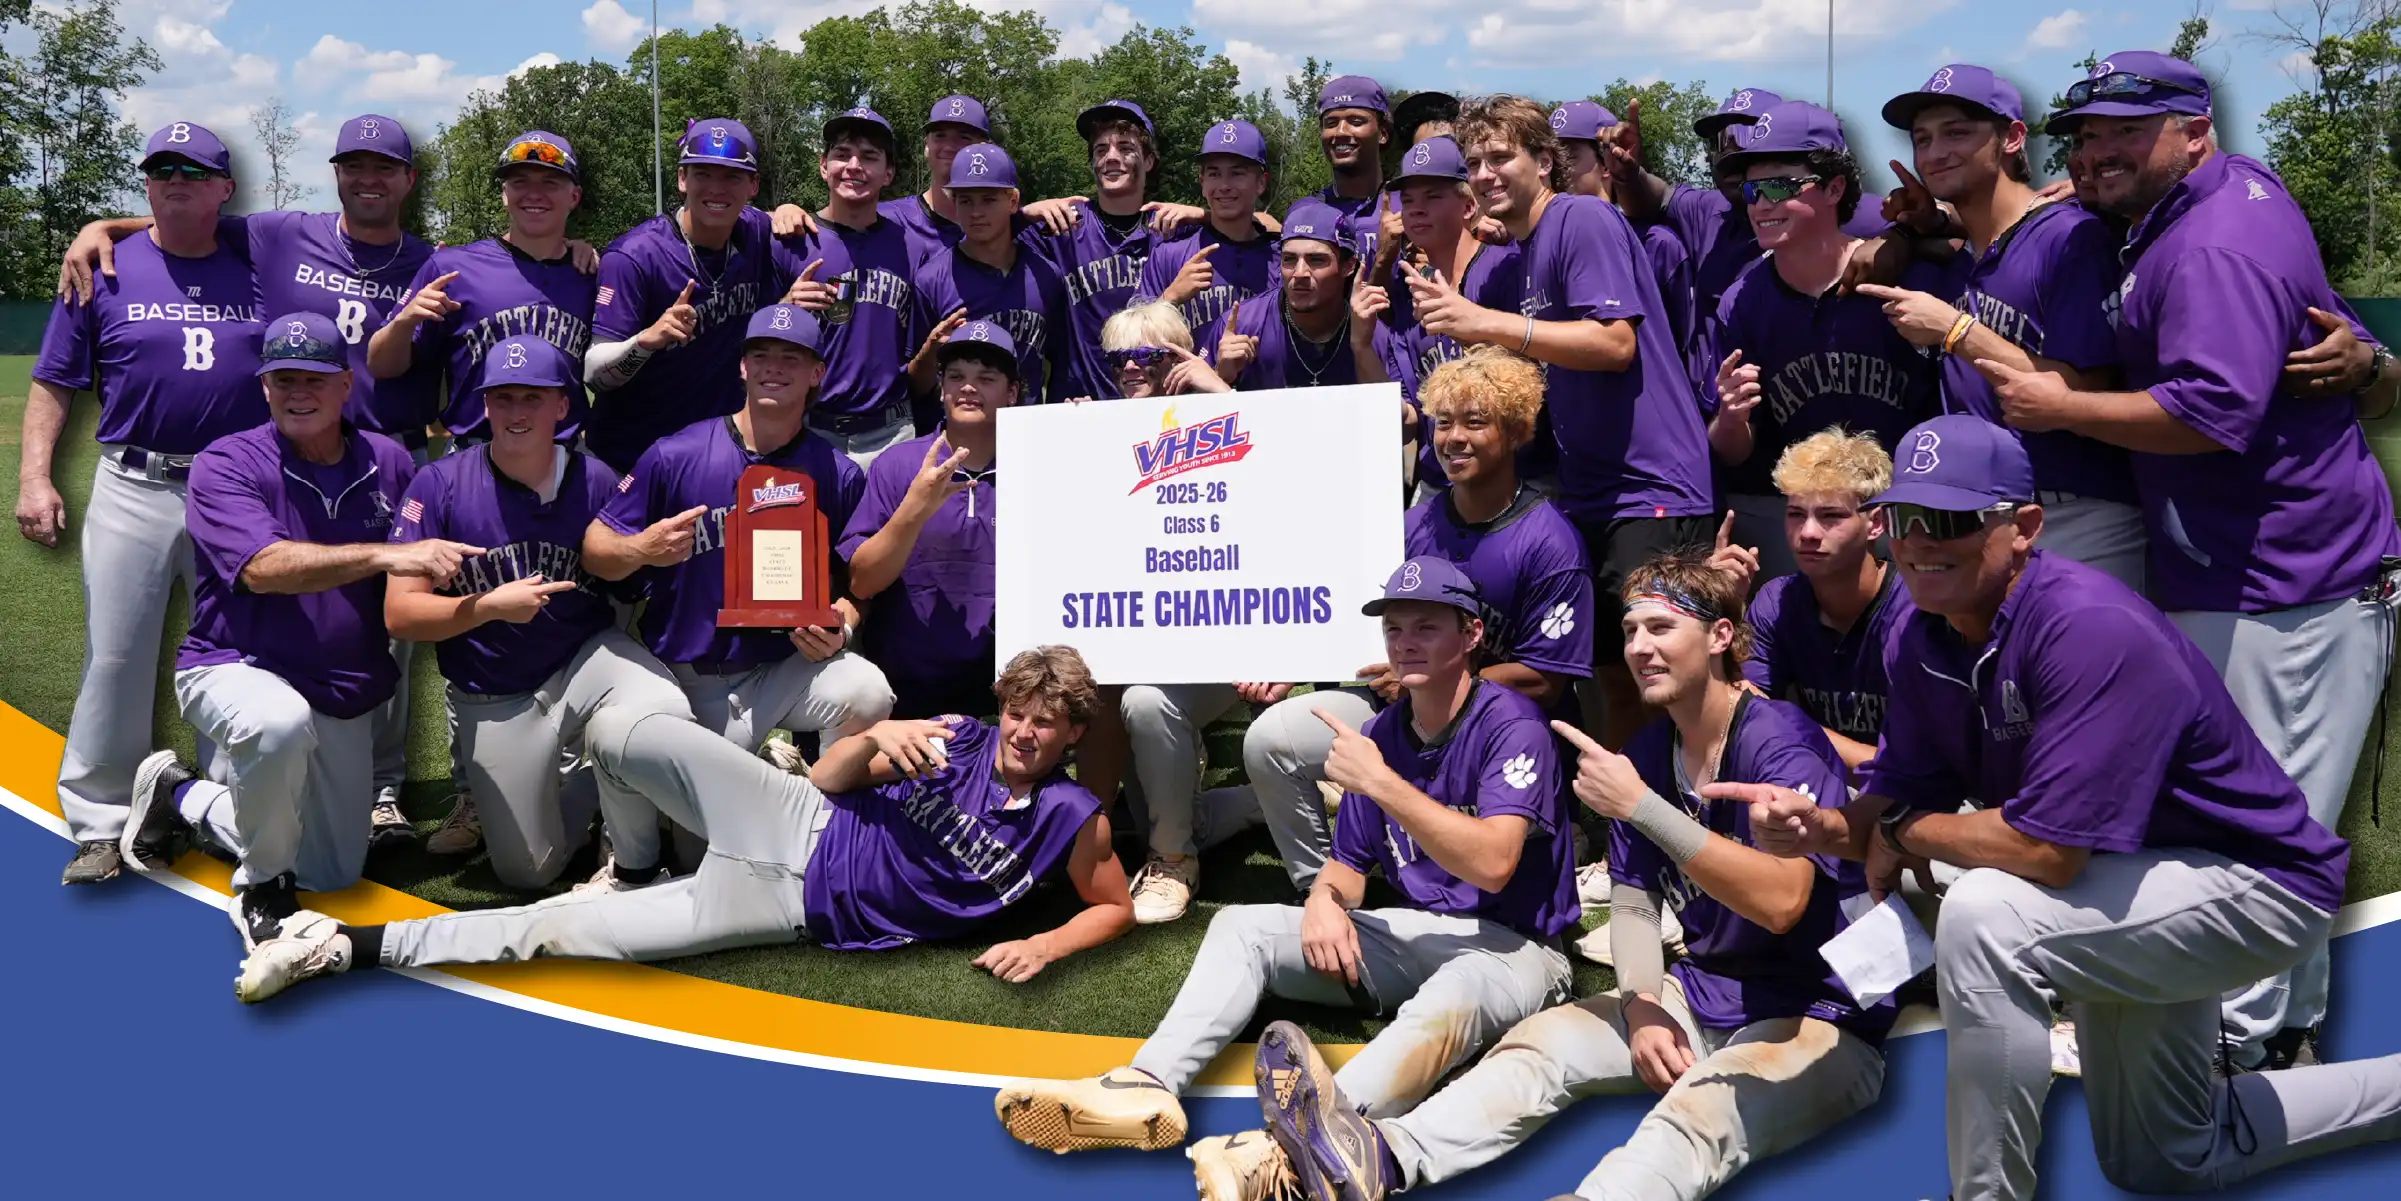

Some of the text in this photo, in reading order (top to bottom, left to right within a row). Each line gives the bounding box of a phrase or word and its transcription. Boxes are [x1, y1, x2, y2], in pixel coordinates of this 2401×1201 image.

[1930, 68, 1953, 93] B
[945, 99, 966, 117] B
[1728, 90, 1753, 112] B
[357, 119, 381, 140] B
[1552, 108, 1568, 129] B
[1750, 113, 1773, 142] B
[166, 123, 191, 143] B
[1220, 123, 1238, 144] B
[968, 153, 988, 176] B
[1412, 143, 1431, 168] B
[127, 303, 260, 322] BASEBALL
[335, 298, 367, 345] B
[769, 307, 793, 331] B
[969, 321, 989, 342] B
[182, 326, 216, 371] B
[502, 343, 528, 369] B
[1133, 411, 1250, 477] VHSL
[1904, 430, 1941, 474] B
[1153, 450, 1237, 480] SERVING YOUTH SINCE 1913
[752, 482, 804, 503] VHSL
[1156, 481, 1228, 505] 2025-26
[1164, 514, 1220, 535] Class 6
[1145, 544, 1240, 574] Baseball
[1396, 562, 1421, 592] B
[1062, 585, 1332, 628] STATE CHAMPIONS
[1280, 1066, 1302, 1110] adidas
